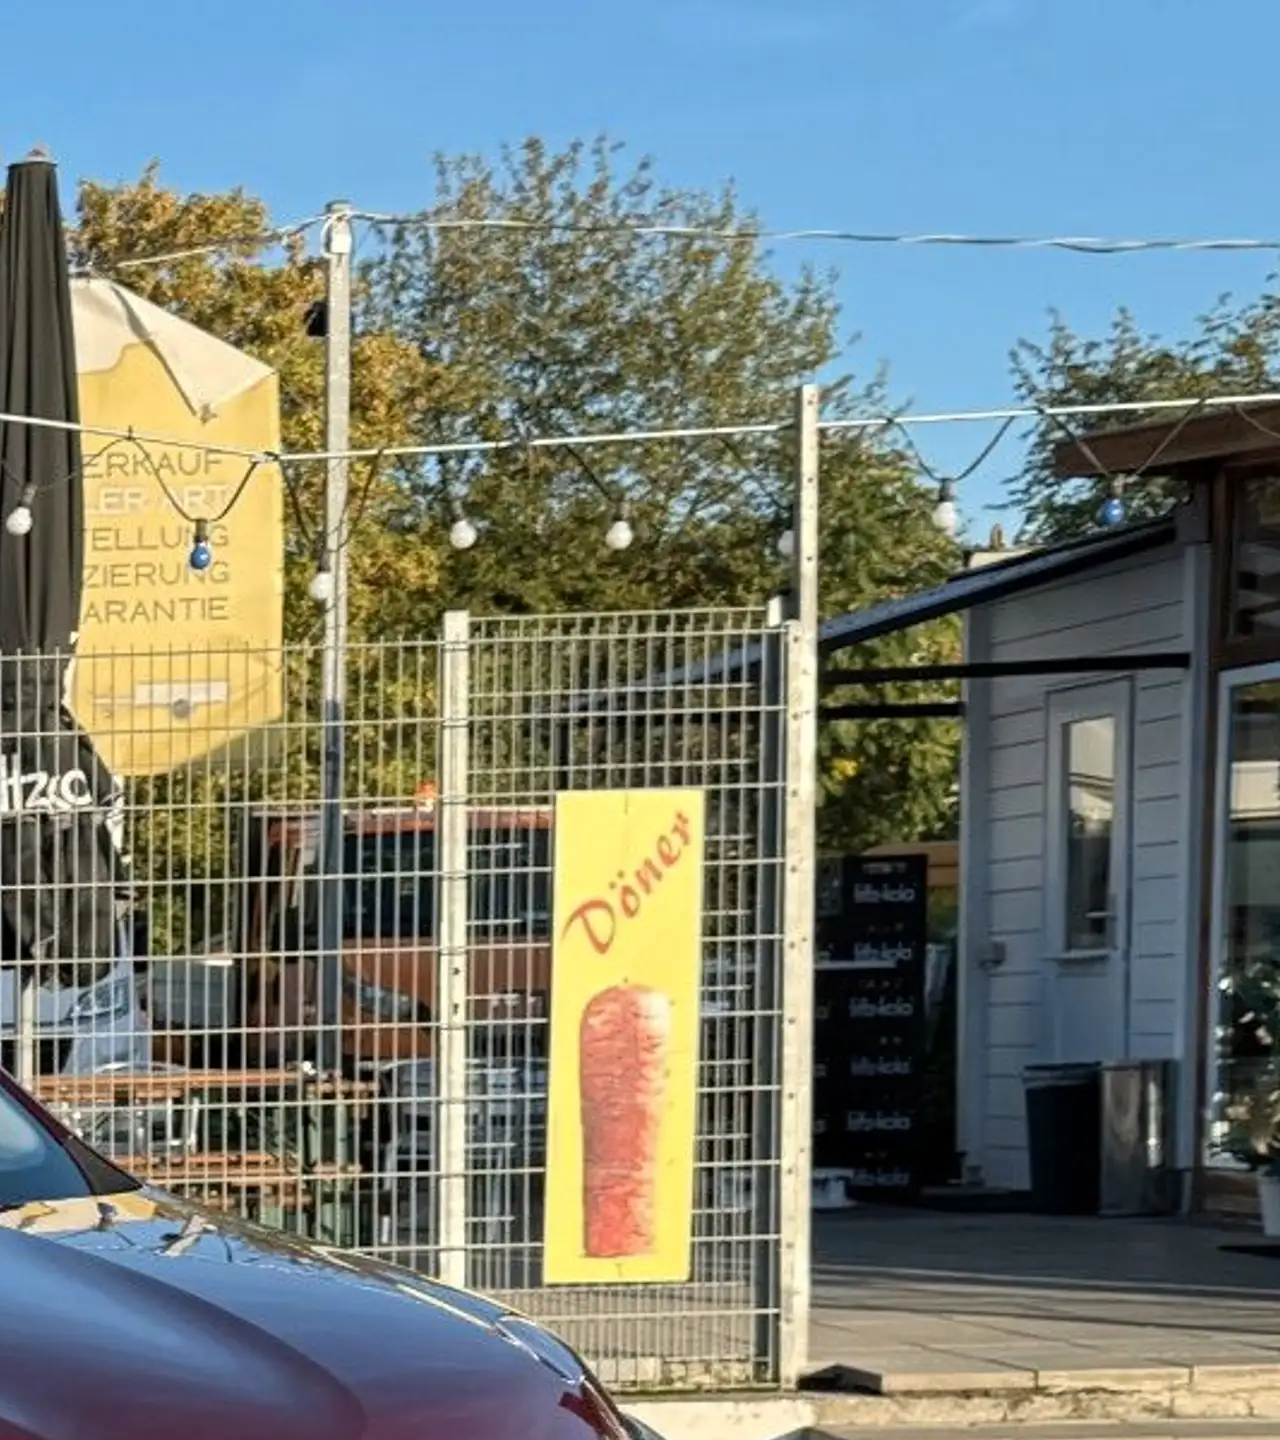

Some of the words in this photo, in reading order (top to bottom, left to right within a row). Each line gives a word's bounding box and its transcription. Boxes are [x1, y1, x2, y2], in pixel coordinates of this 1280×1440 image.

[82, 450, 222, 479] ERKAUF
[82, 597, 230, 624] ARANTIE
[560, 809, 692, 956] Döner
